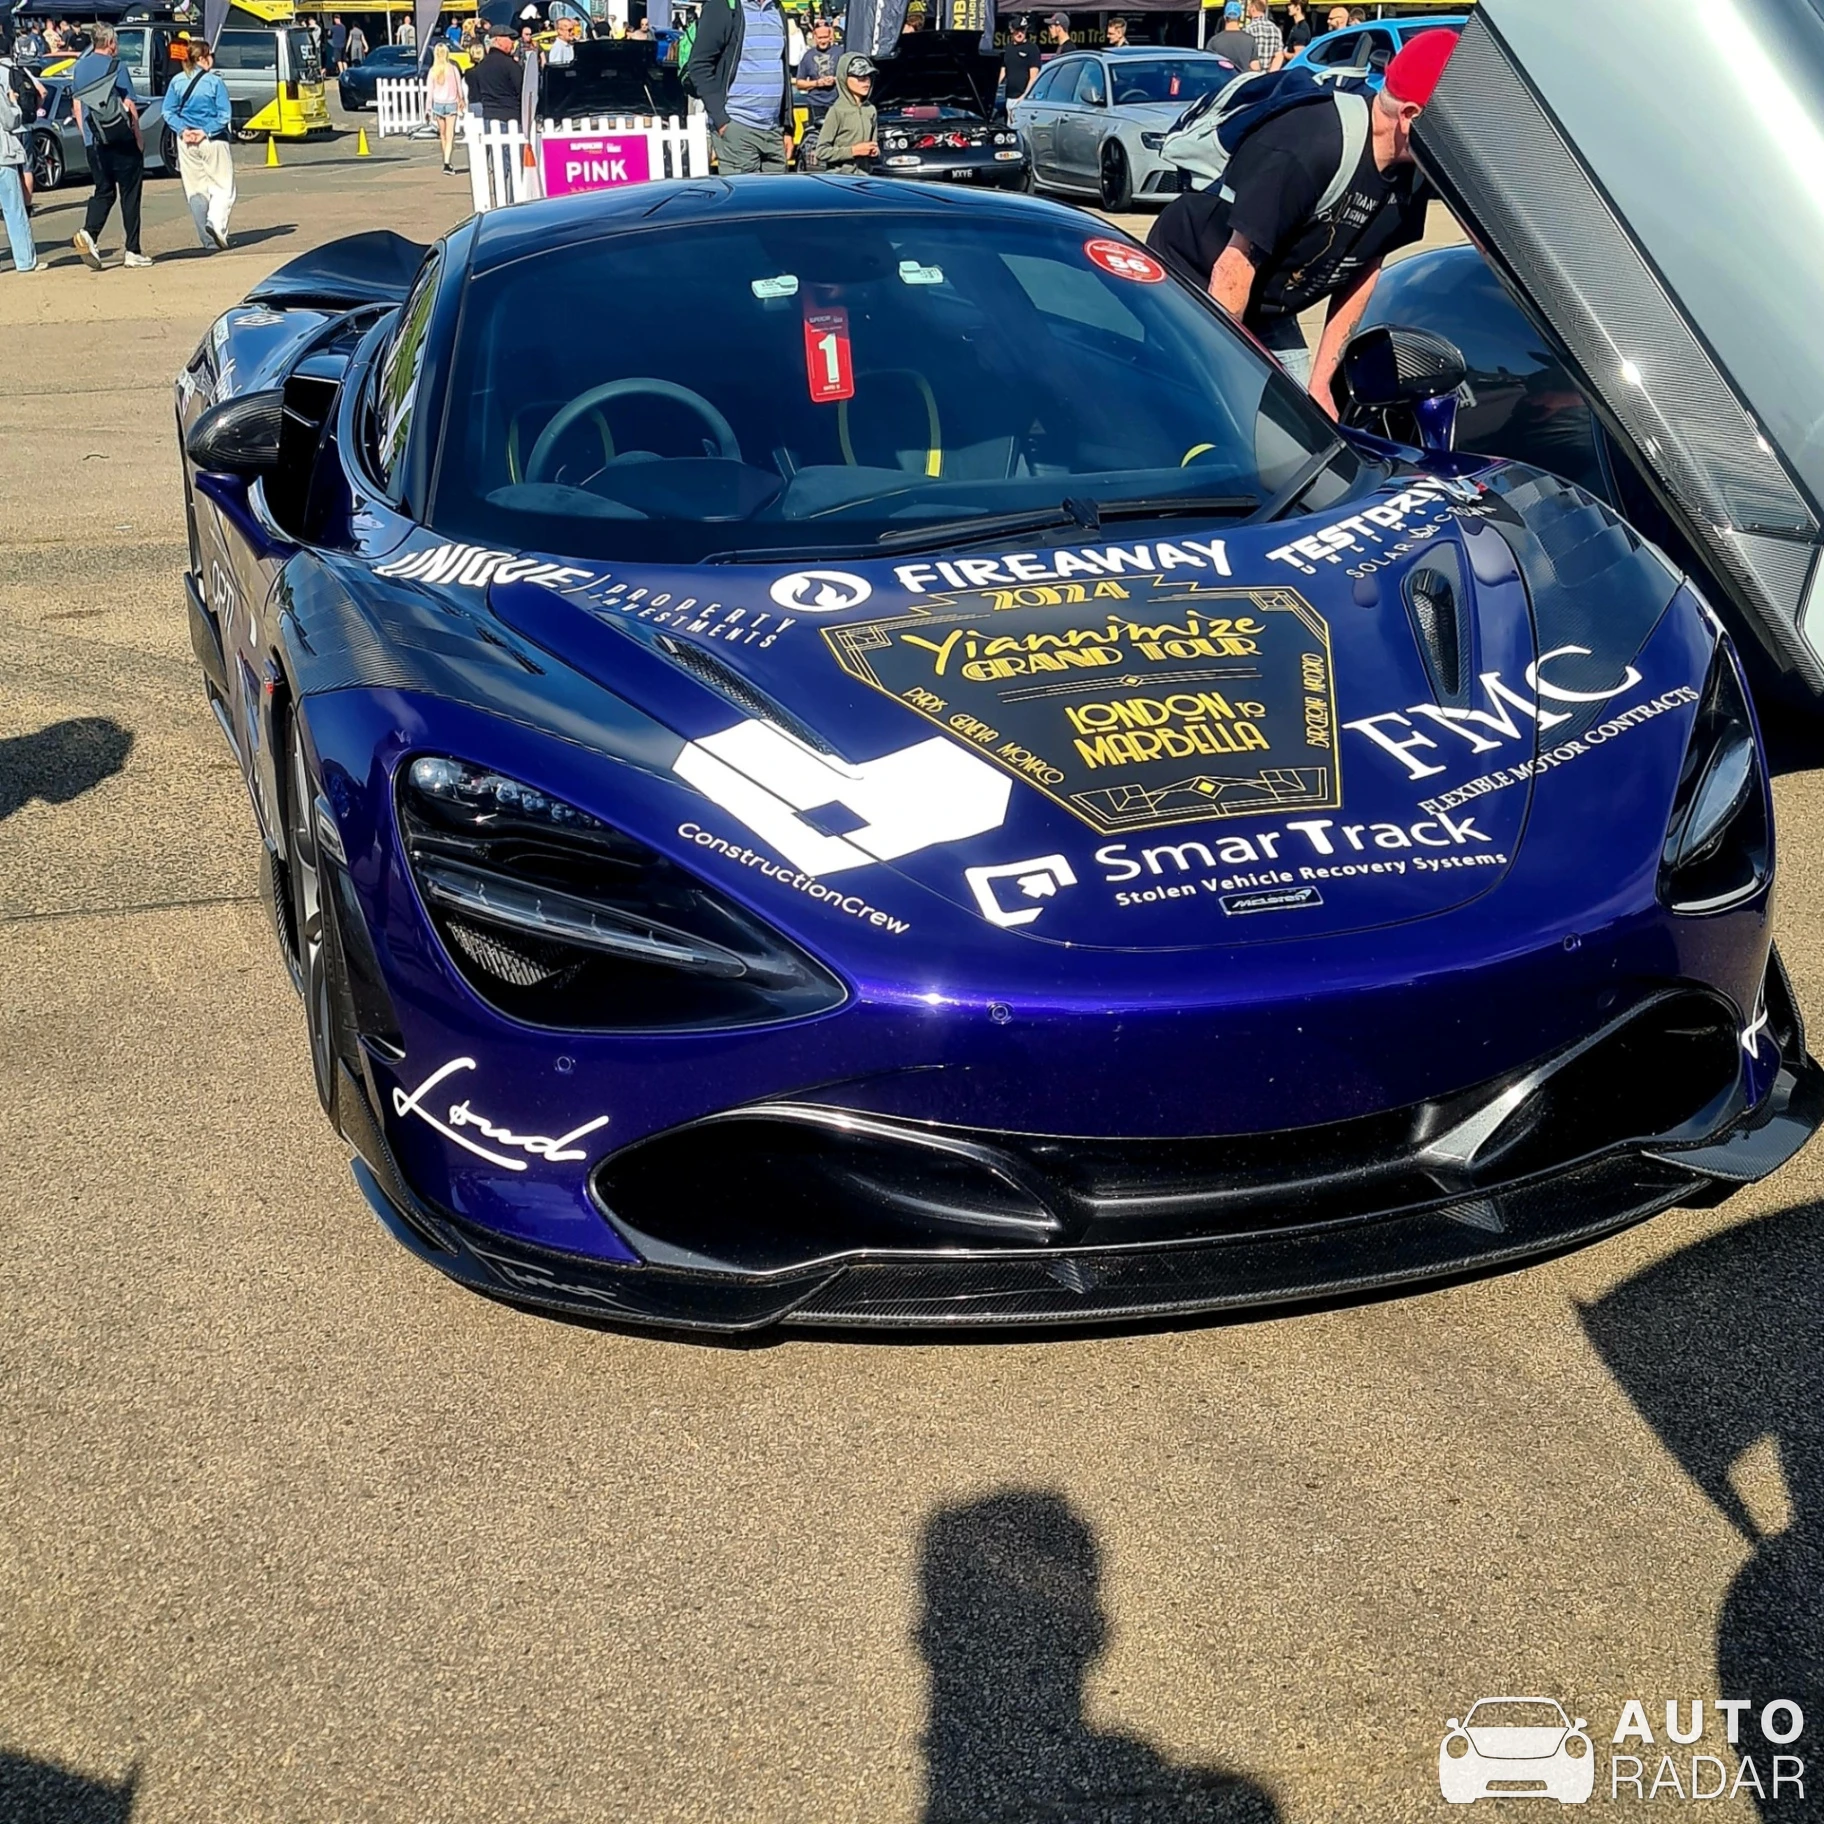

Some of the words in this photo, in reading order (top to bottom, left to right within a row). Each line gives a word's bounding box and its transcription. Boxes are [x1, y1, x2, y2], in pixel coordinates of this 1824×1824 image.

[566, 160, 628, 184] PINK
[1105, 254, 1151, 273] 56
[818, 332, 840, 384] 1
[371, 543, 595, 588] UNIQUE
[893, 539, 1234, 594] FIREAWAY
[1345, 541, 1415, 580] SOLAR
[588, 592, 779, 650] INVESTMENTS
[605, 583, 797, 635] PROPERTY
[980, 579, 1131, 612] 2024
[900, 609, 1267, 677] Yiannimize
[961, 645, 1124, 682] GRAND
[1133, 636, 1263, 662] TOUR
[902, 686, 949, 713] PARIS
[949, 713, 1000, 743] GENEVA
[996, 741, 1065, 786] MONACO
[1065, 691, 1234, 737] LONDON
[1341, 644, 1643, 781] FMC
[1072, 721, 1271, 771] MARBELLA
[1417, 769, 1515, 816] FLEXIBLE
[1508, 739, 1591, 782] MOTOR
[1583, 685, 1701, 746] CONTRACTS
[677, 822, 911, 935] ConstructionCrew
[1115, 881, 1197, 907] Stolen
[1201, 869, 1294, 892] Vehicle
[1299, 858, 1406, 880] Recovery
[1413, 851, 1508, 873] Systems
